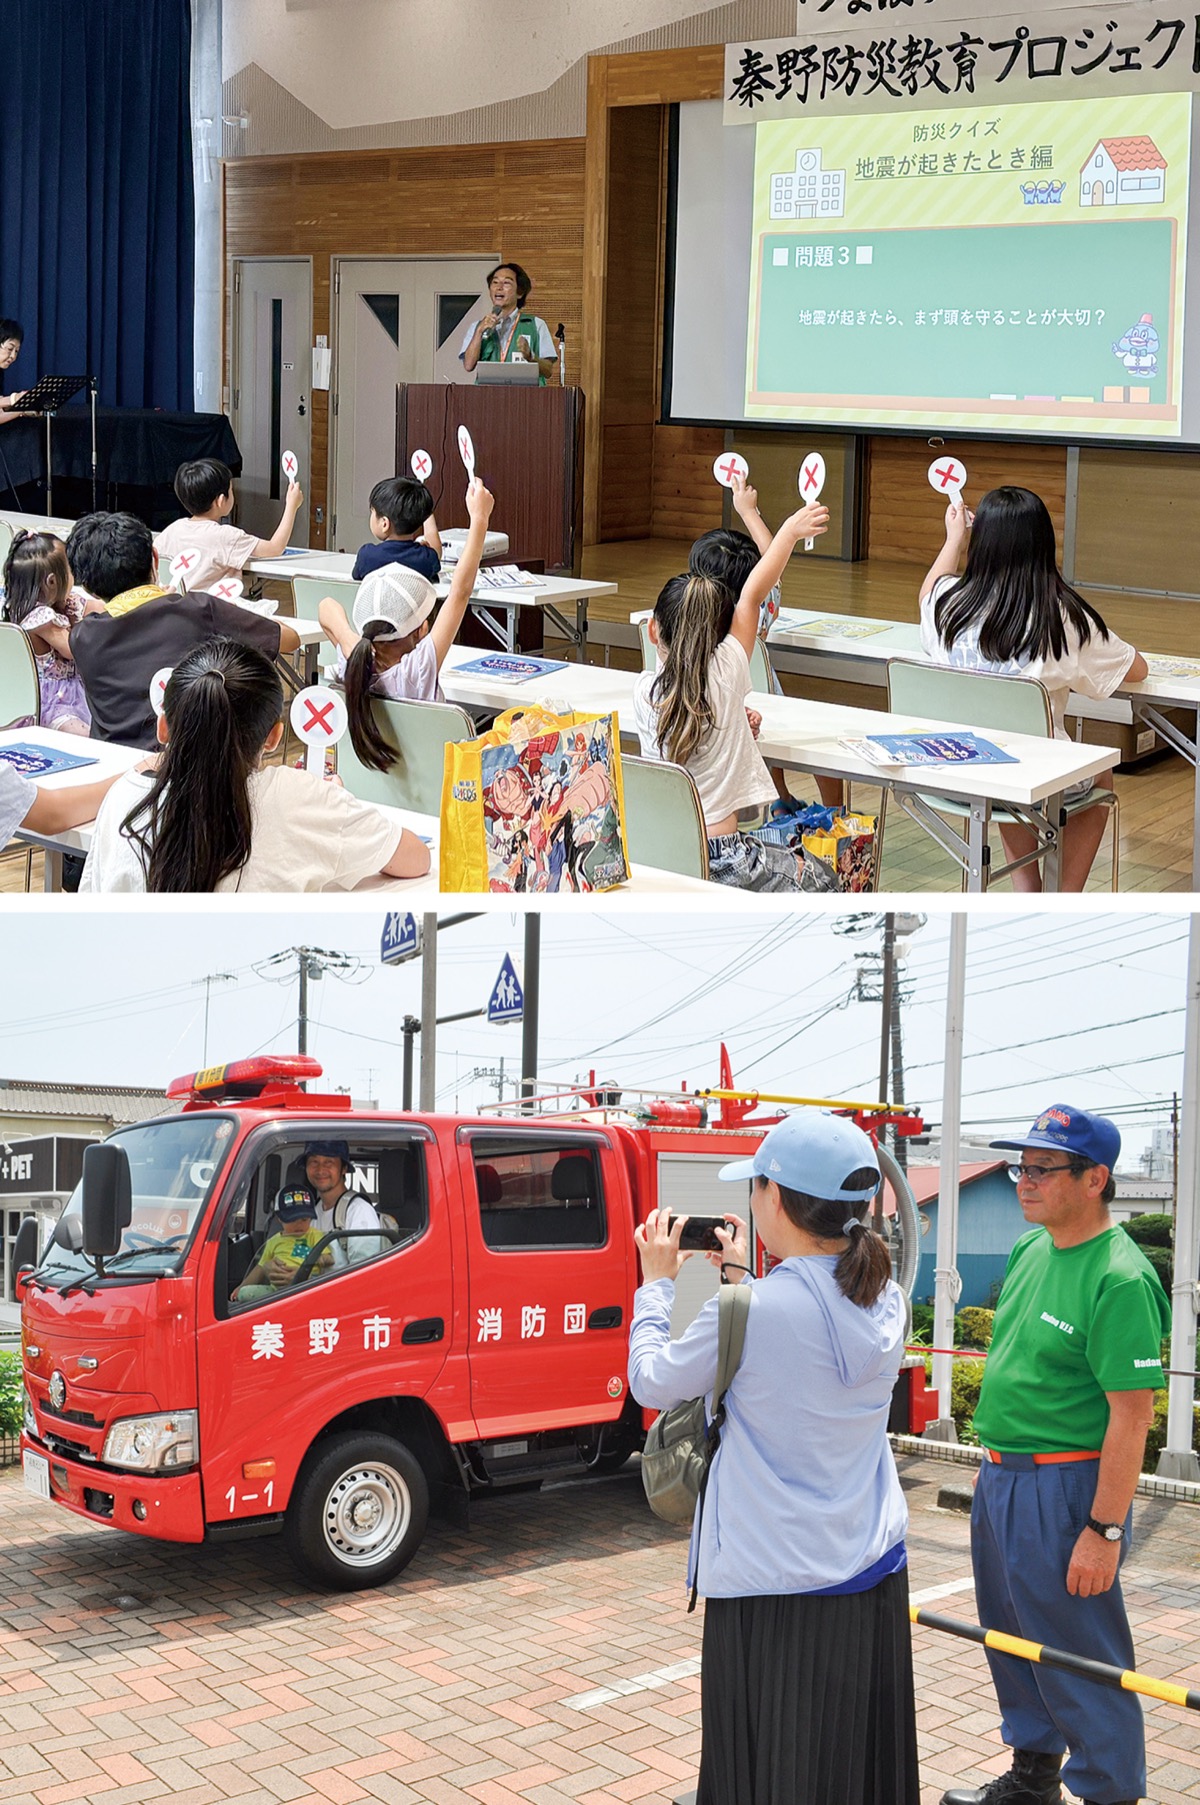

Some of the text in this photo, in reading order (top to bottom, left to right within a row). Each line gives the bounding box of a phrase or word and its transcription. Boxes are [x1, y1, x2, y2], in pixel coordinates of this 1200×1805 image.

[913, 117, 1002, 143] 防災クイズ
[855, 145, 1054, 179] 地震が起きたとき編
[251, 1303, 586, 1360] 秦野市 消防団
[225, 1481, 274, 1513] 1-1
